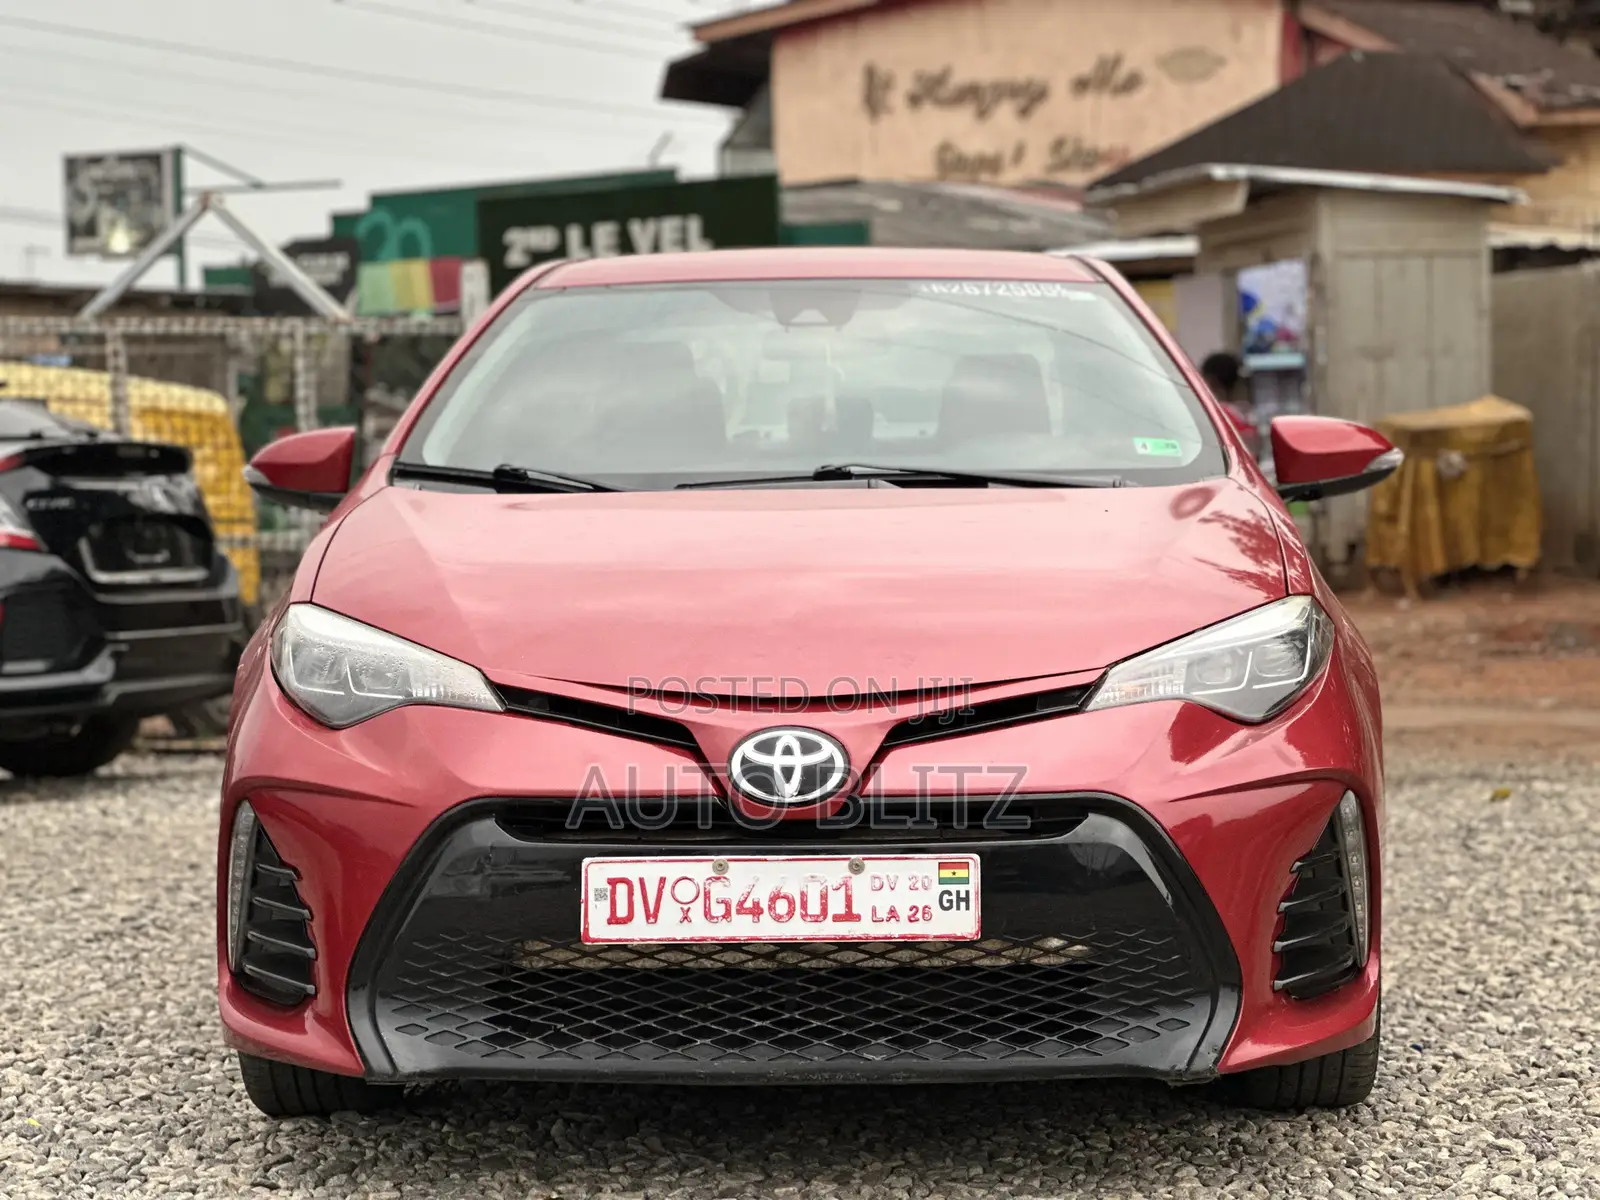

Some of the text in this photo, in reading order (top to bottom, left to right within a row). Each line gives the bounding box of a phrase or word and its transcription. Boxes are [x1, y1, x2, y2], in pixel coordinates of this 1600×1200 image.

[870, 875, 933, 891] DV 20
[606, 876, 667, 925] DV
[938, 889, 970, 911] GH
[871, 904, 933, 922] LA 26
